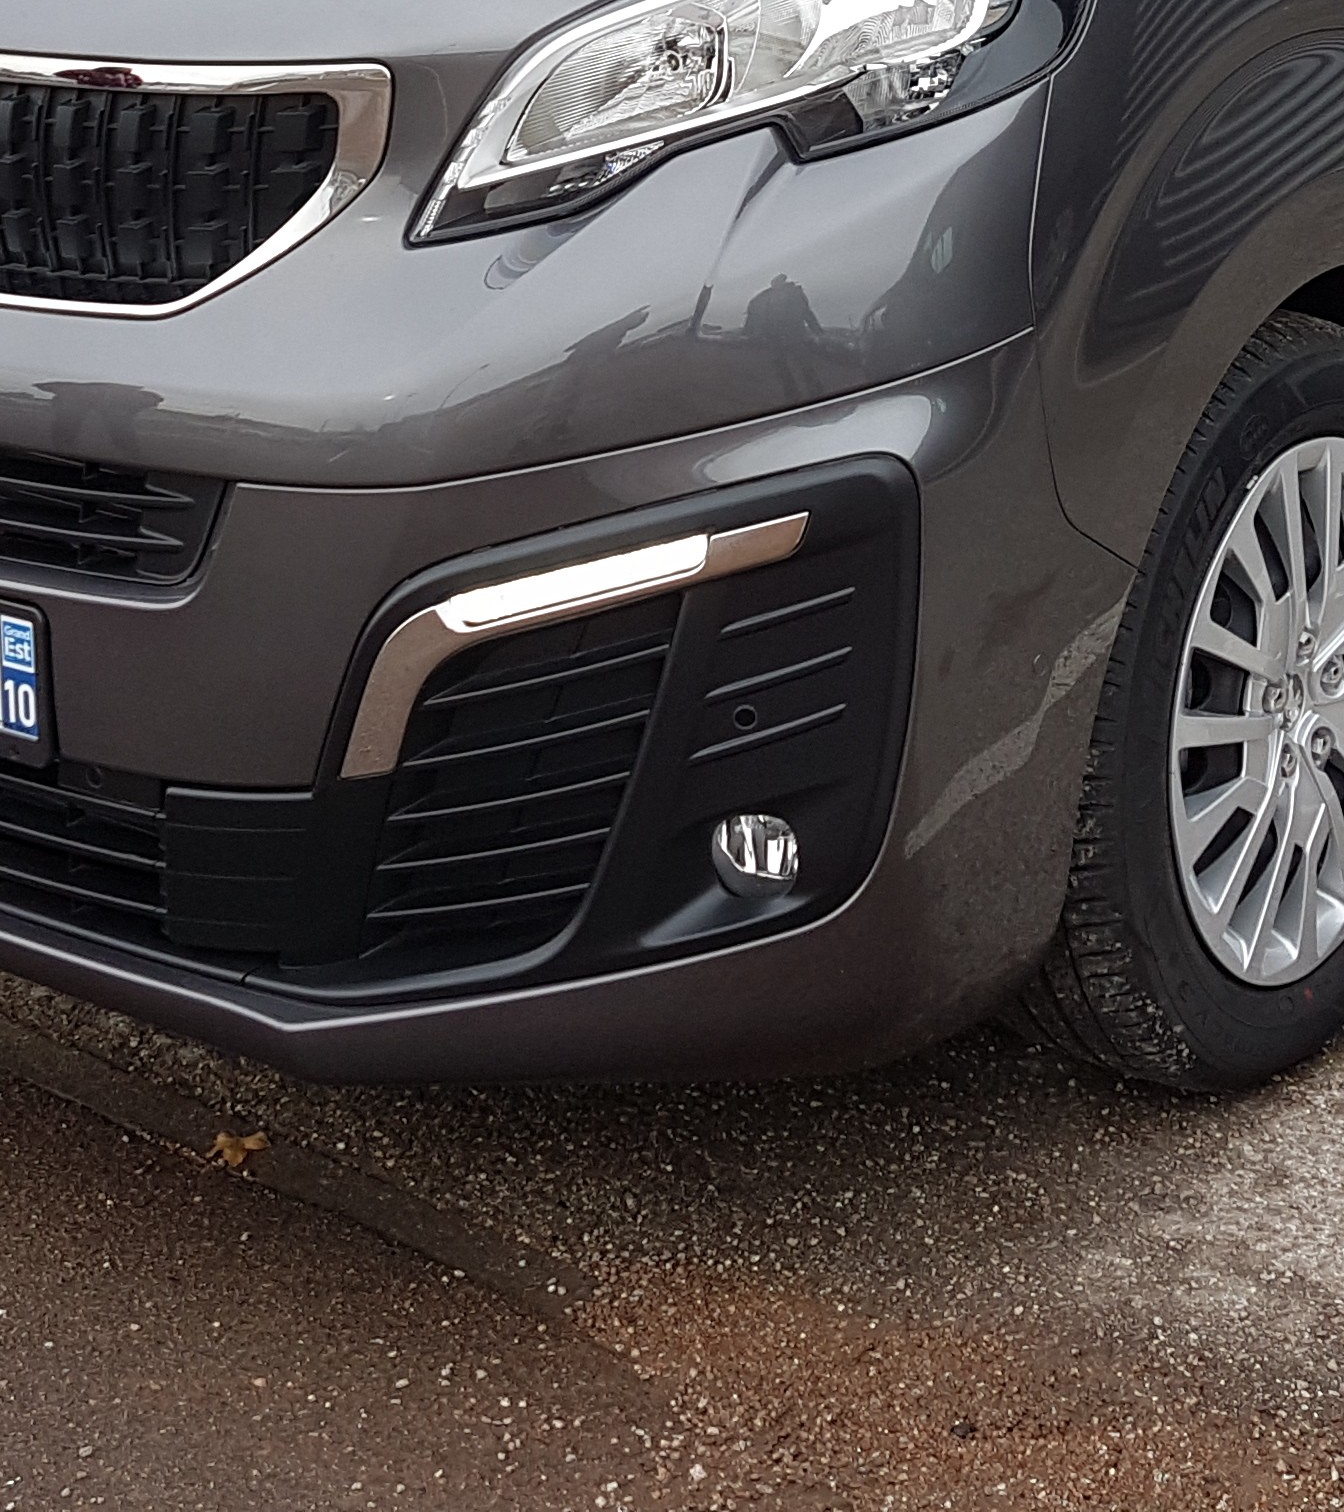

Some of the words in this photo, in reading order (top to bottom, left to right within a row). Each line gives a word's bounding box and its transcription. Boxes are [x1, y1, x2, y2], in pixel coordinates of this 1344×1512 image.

[2, 623, 31, 641] Grand
[3, 636, 32, 662] Est
[2, 678, 36, 729] 10
